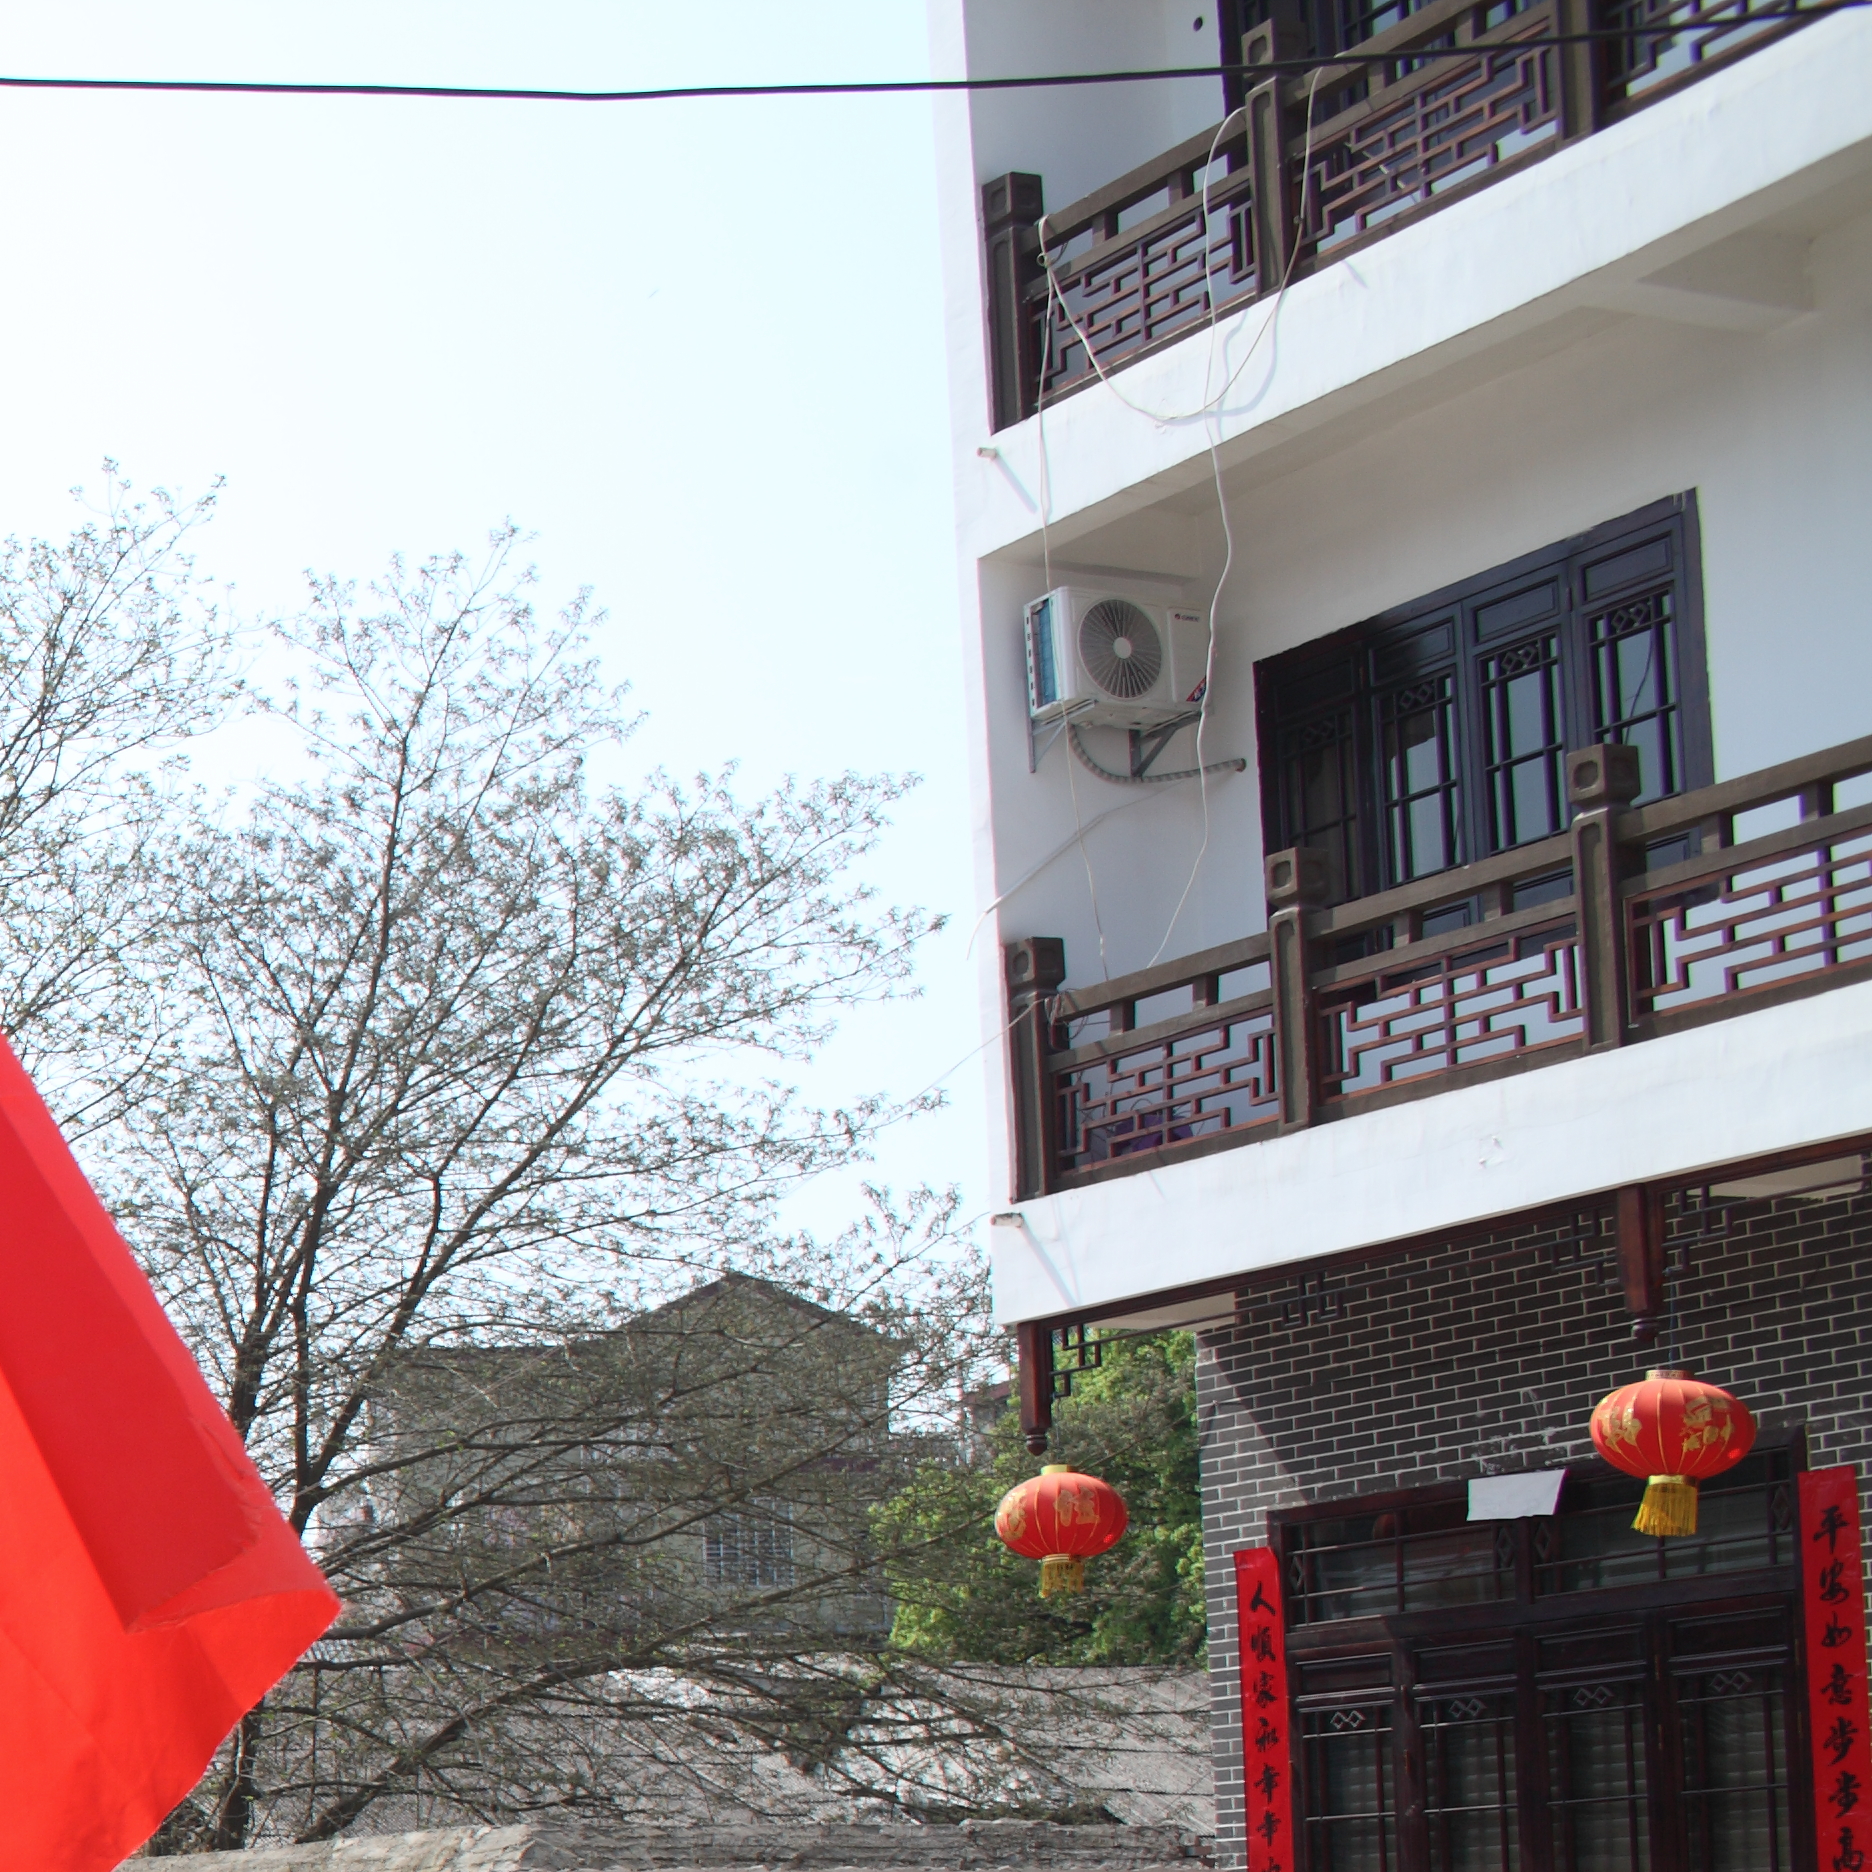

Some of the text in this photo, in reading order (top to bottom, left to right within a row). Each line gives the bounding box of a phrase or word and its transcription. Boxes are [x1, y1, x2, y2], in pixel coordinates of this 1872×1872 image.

[1813, 1505, 1865, 1872] 平安如意步步高
